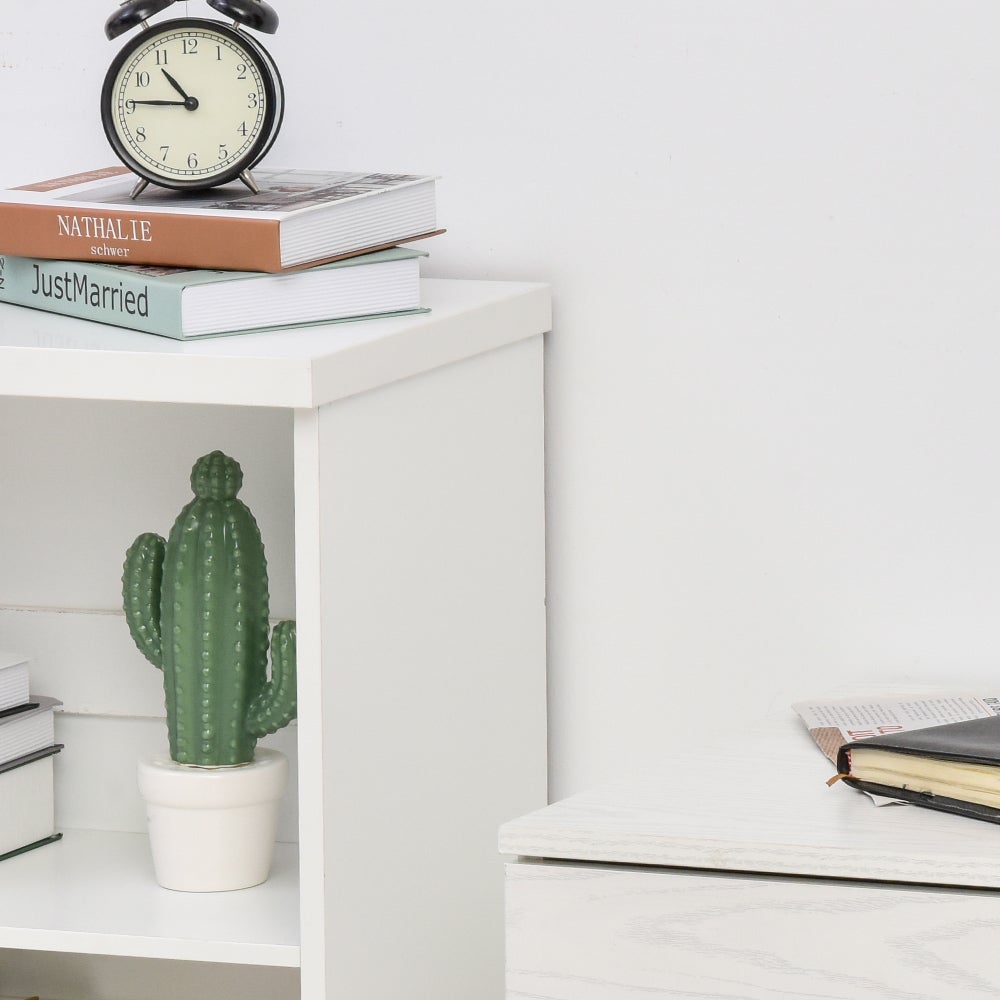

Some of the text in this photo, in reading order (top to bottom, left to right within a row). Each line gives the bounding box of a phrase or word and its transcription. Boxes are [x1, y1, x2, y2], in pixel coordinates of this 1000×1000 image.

[182, 38, 198, 55] 12
[215, 45, 223, 61] 1
[155, 49, 168, 66] 11
[135, 71, 150, 88] 10
[236, 63, 247, 80] 2
[125, 99, 136, 115] 9
[247, 92, 258, 109] 3
[135, 126, 147, 143] 8
[236, 120, 249, 137] 4
[159, 145, 170, 162] 7
[217, 143, 229, 160] 5
[187, 152, 198, 169] 6
[57, 214, 153, 242] NATHALIE
[90, 243, 130, 257] schwer
[32, 264, 149, 318] JustMarried
